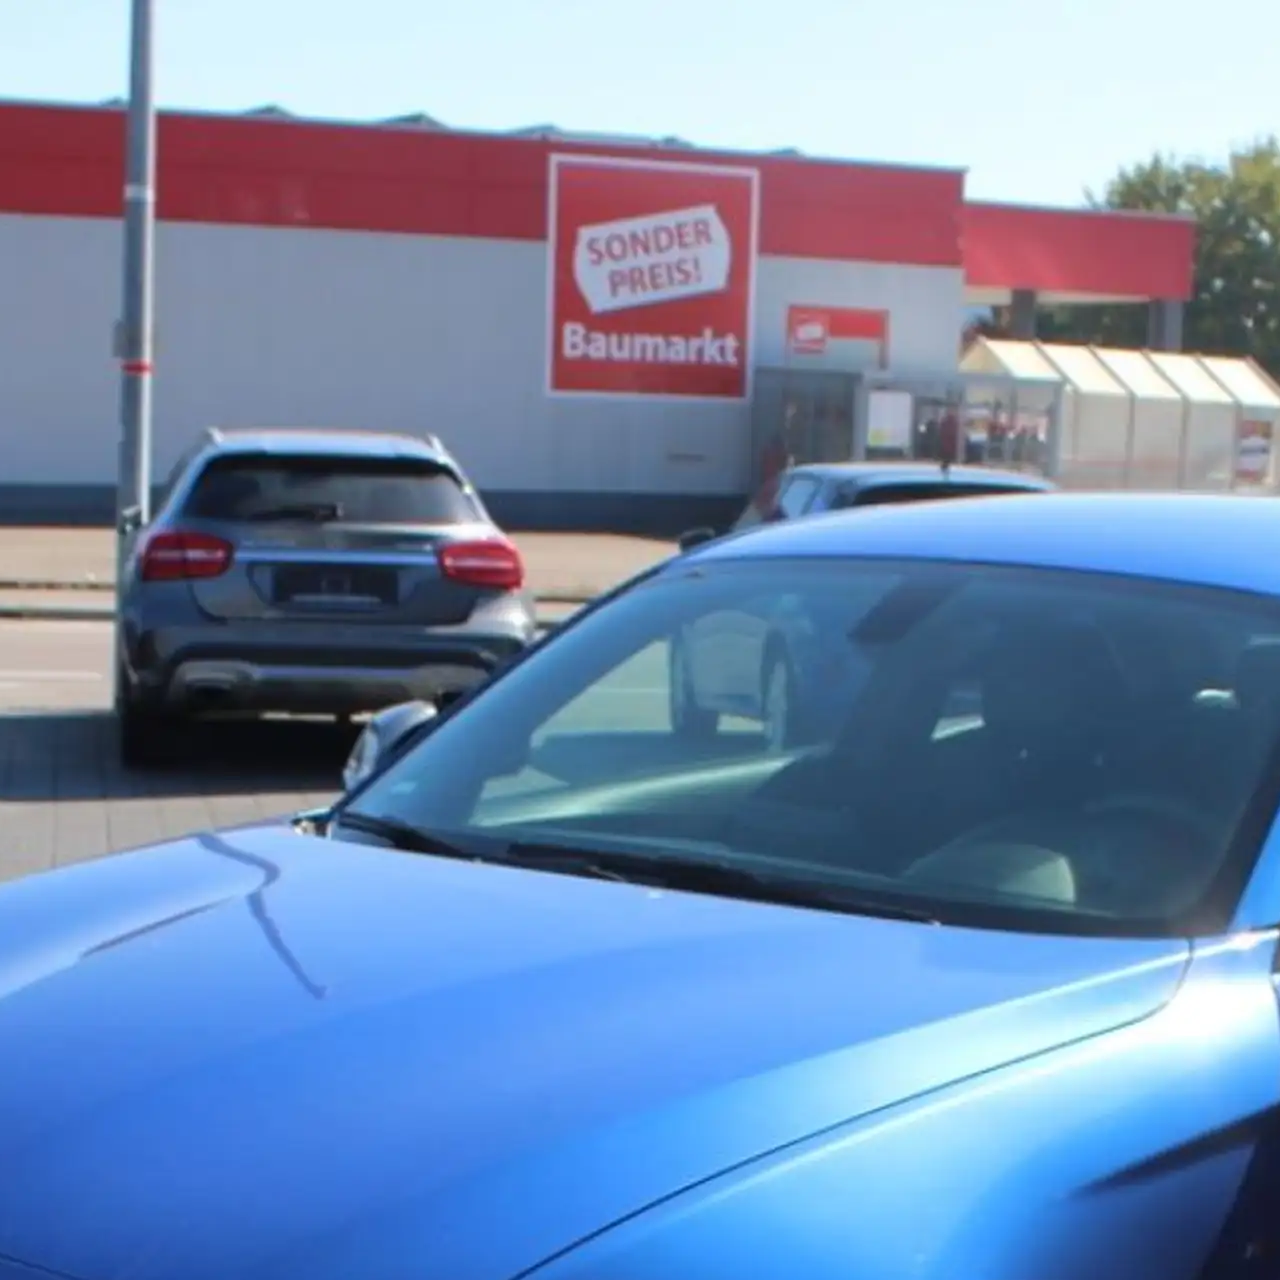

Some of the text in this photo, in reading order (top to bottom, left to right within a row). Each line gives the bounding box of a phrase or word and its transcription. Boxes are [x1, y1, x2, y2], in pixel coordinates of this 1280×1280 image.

[586, 217, 714, 266] SONDER
[608, 257, 703, 298] PREIS!
[562, 321, 740, 366] Baumarkt
